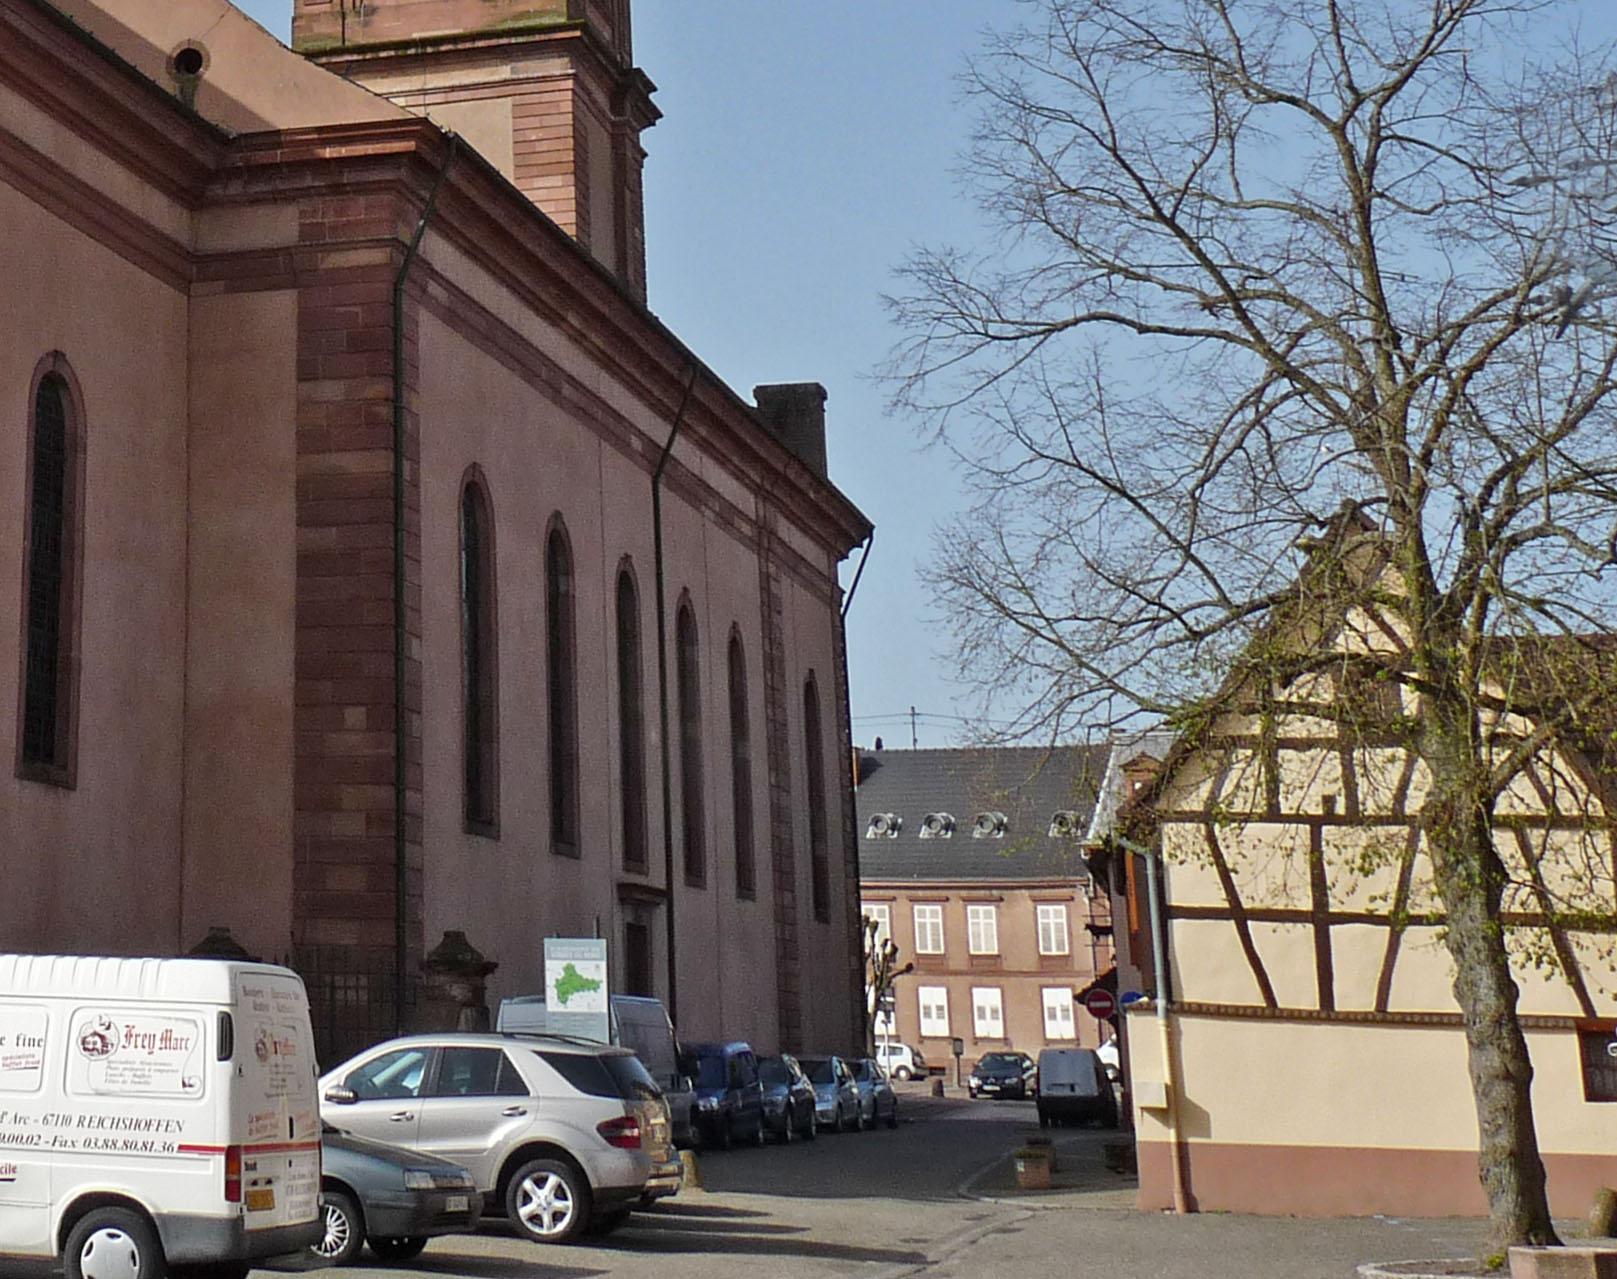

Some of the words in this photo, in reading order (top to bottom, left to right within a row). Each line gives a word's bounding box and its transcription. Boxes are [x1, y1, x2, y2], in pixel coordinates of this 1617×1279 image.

[15, 1033, 44, 1048] fine
[122, 1024, 156, 1055] Frey
[158, 1028, 190, 1051] Marc
[10, 1112, 30, 1125] Arc
[41, 1113, 73, 1127] 67110
[76, 1114, 185, 1133] REICHSHOFFEN
